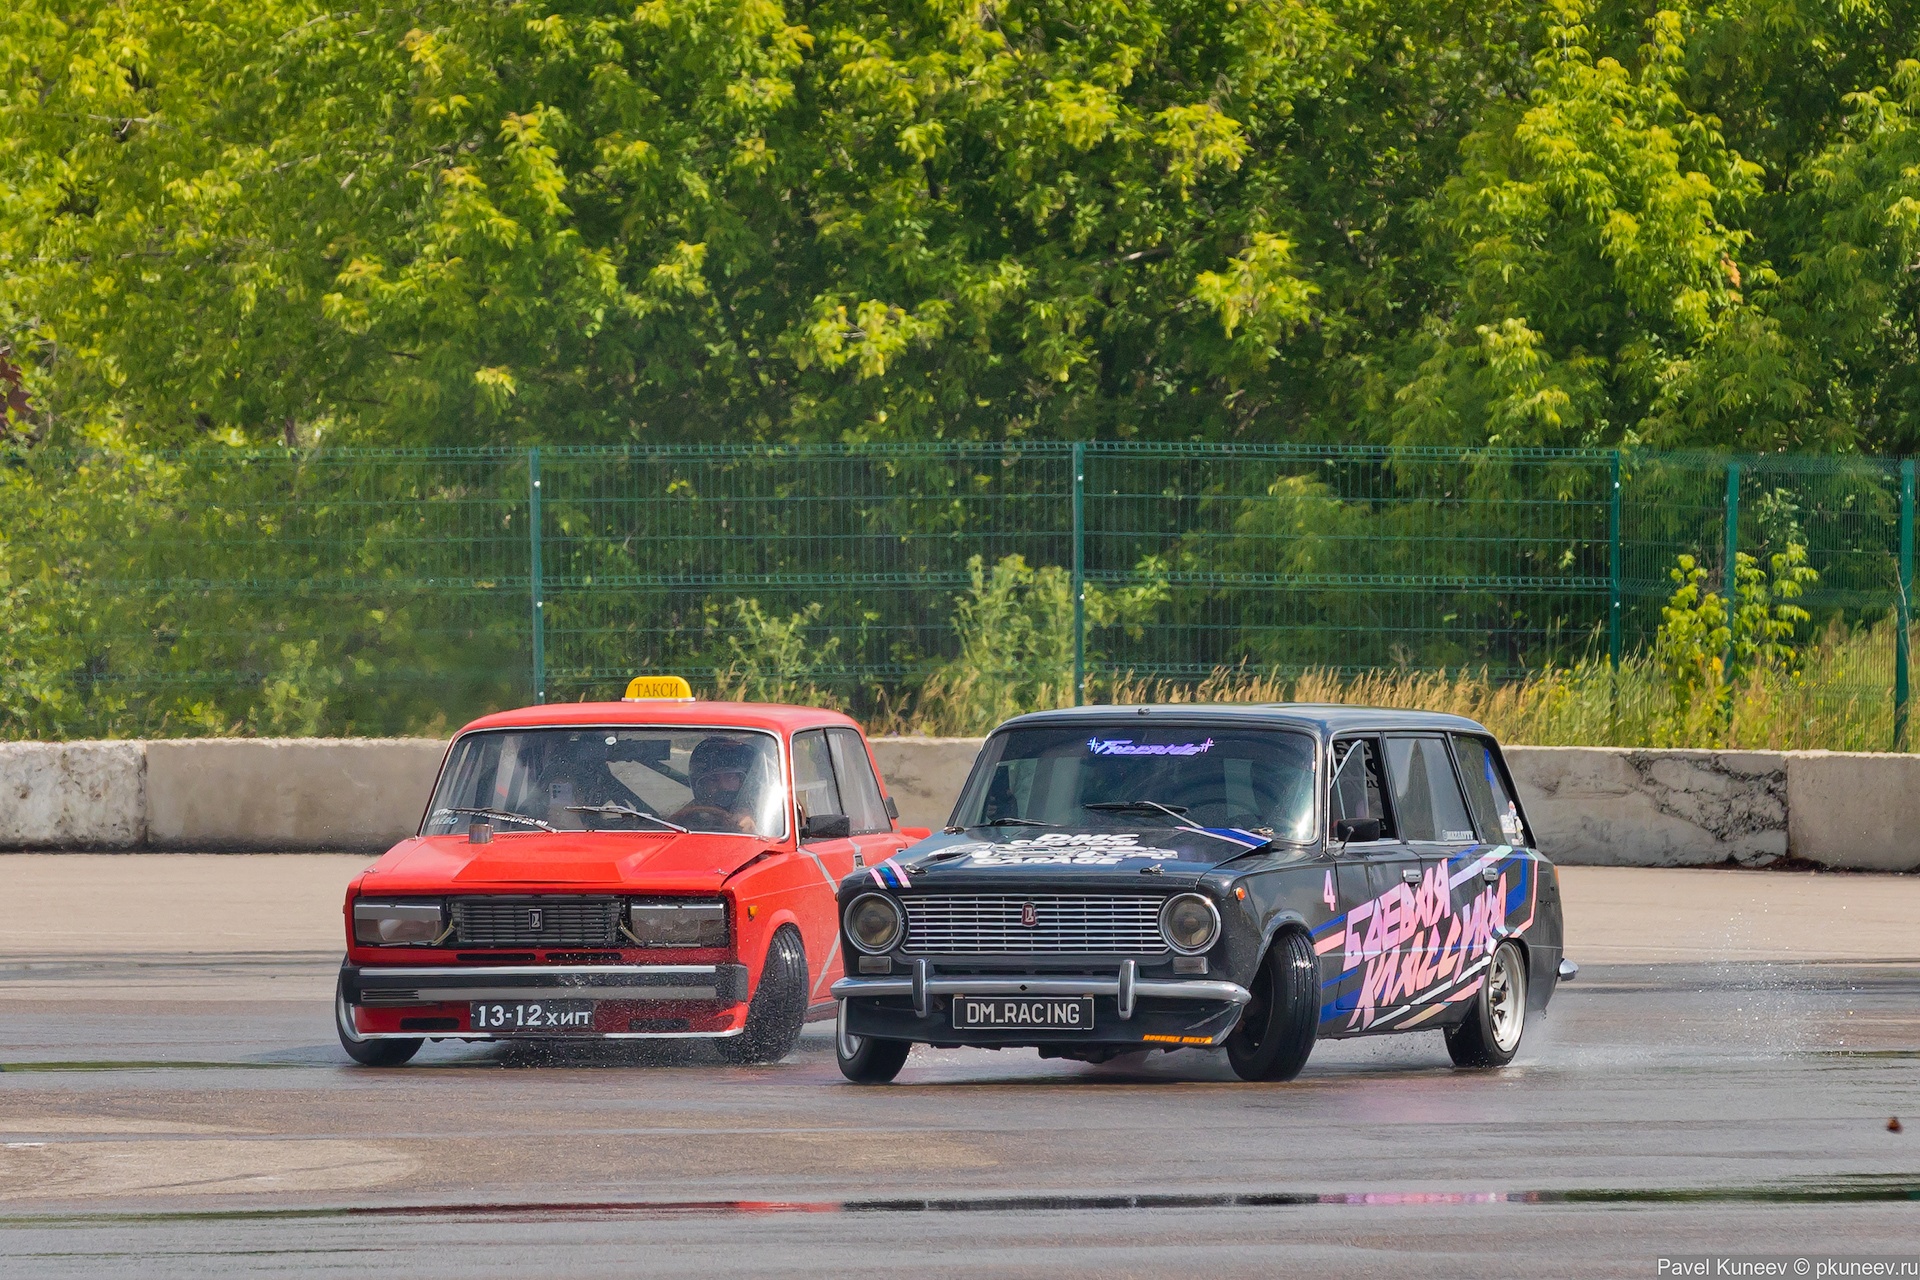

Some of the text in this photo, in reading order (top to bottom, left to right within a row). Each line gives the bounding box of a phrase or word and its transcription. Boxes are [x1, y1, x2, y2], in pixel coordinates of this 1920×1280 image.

[634, 682, 679, 697] ТАКСИ
[1323, 869, 1336, 912] 4
[478, 1003, 543, 1027] 13-12
[965, 1002, 1080, 1025] DM_RACING
